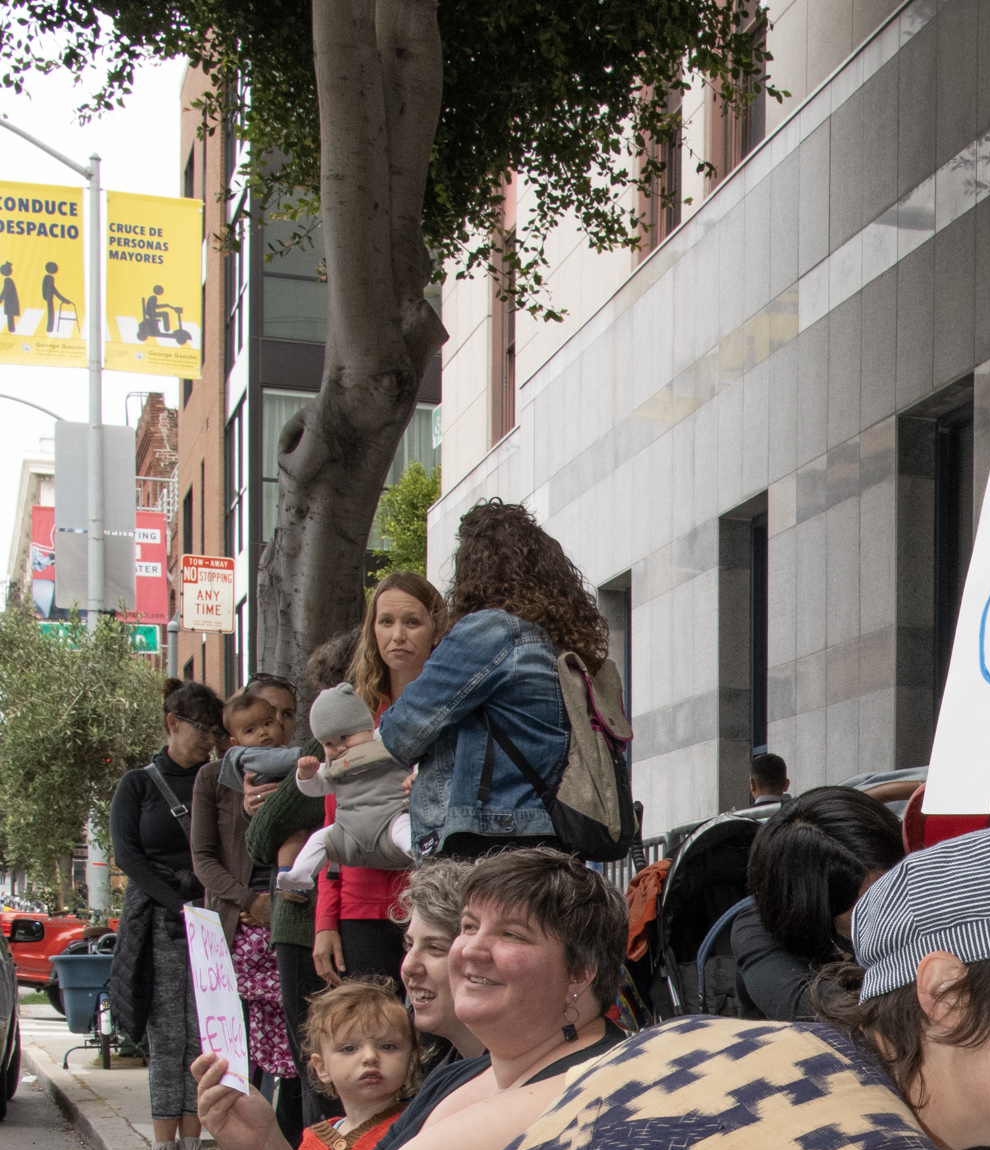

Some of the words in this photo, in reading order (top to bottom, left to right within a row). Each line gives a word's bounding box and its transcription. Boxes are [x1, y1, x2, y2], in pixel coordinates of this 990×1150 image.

[0, 196, 78, 217] ONDUCE
[109, 222, 146, 236] CRUCE
[149, 227, 163, 238] DE
[109, 236, 169, 252] PERSONAS
[109, 250, 164, 265] MAYORES
[148, 350, 172, 359] George
[184, 566, 197, 582] NO
[199, 571, 232, 584] STOPPING
[197, 589, 220, 602] ANY
[195, 603, 221, 616] TIME
